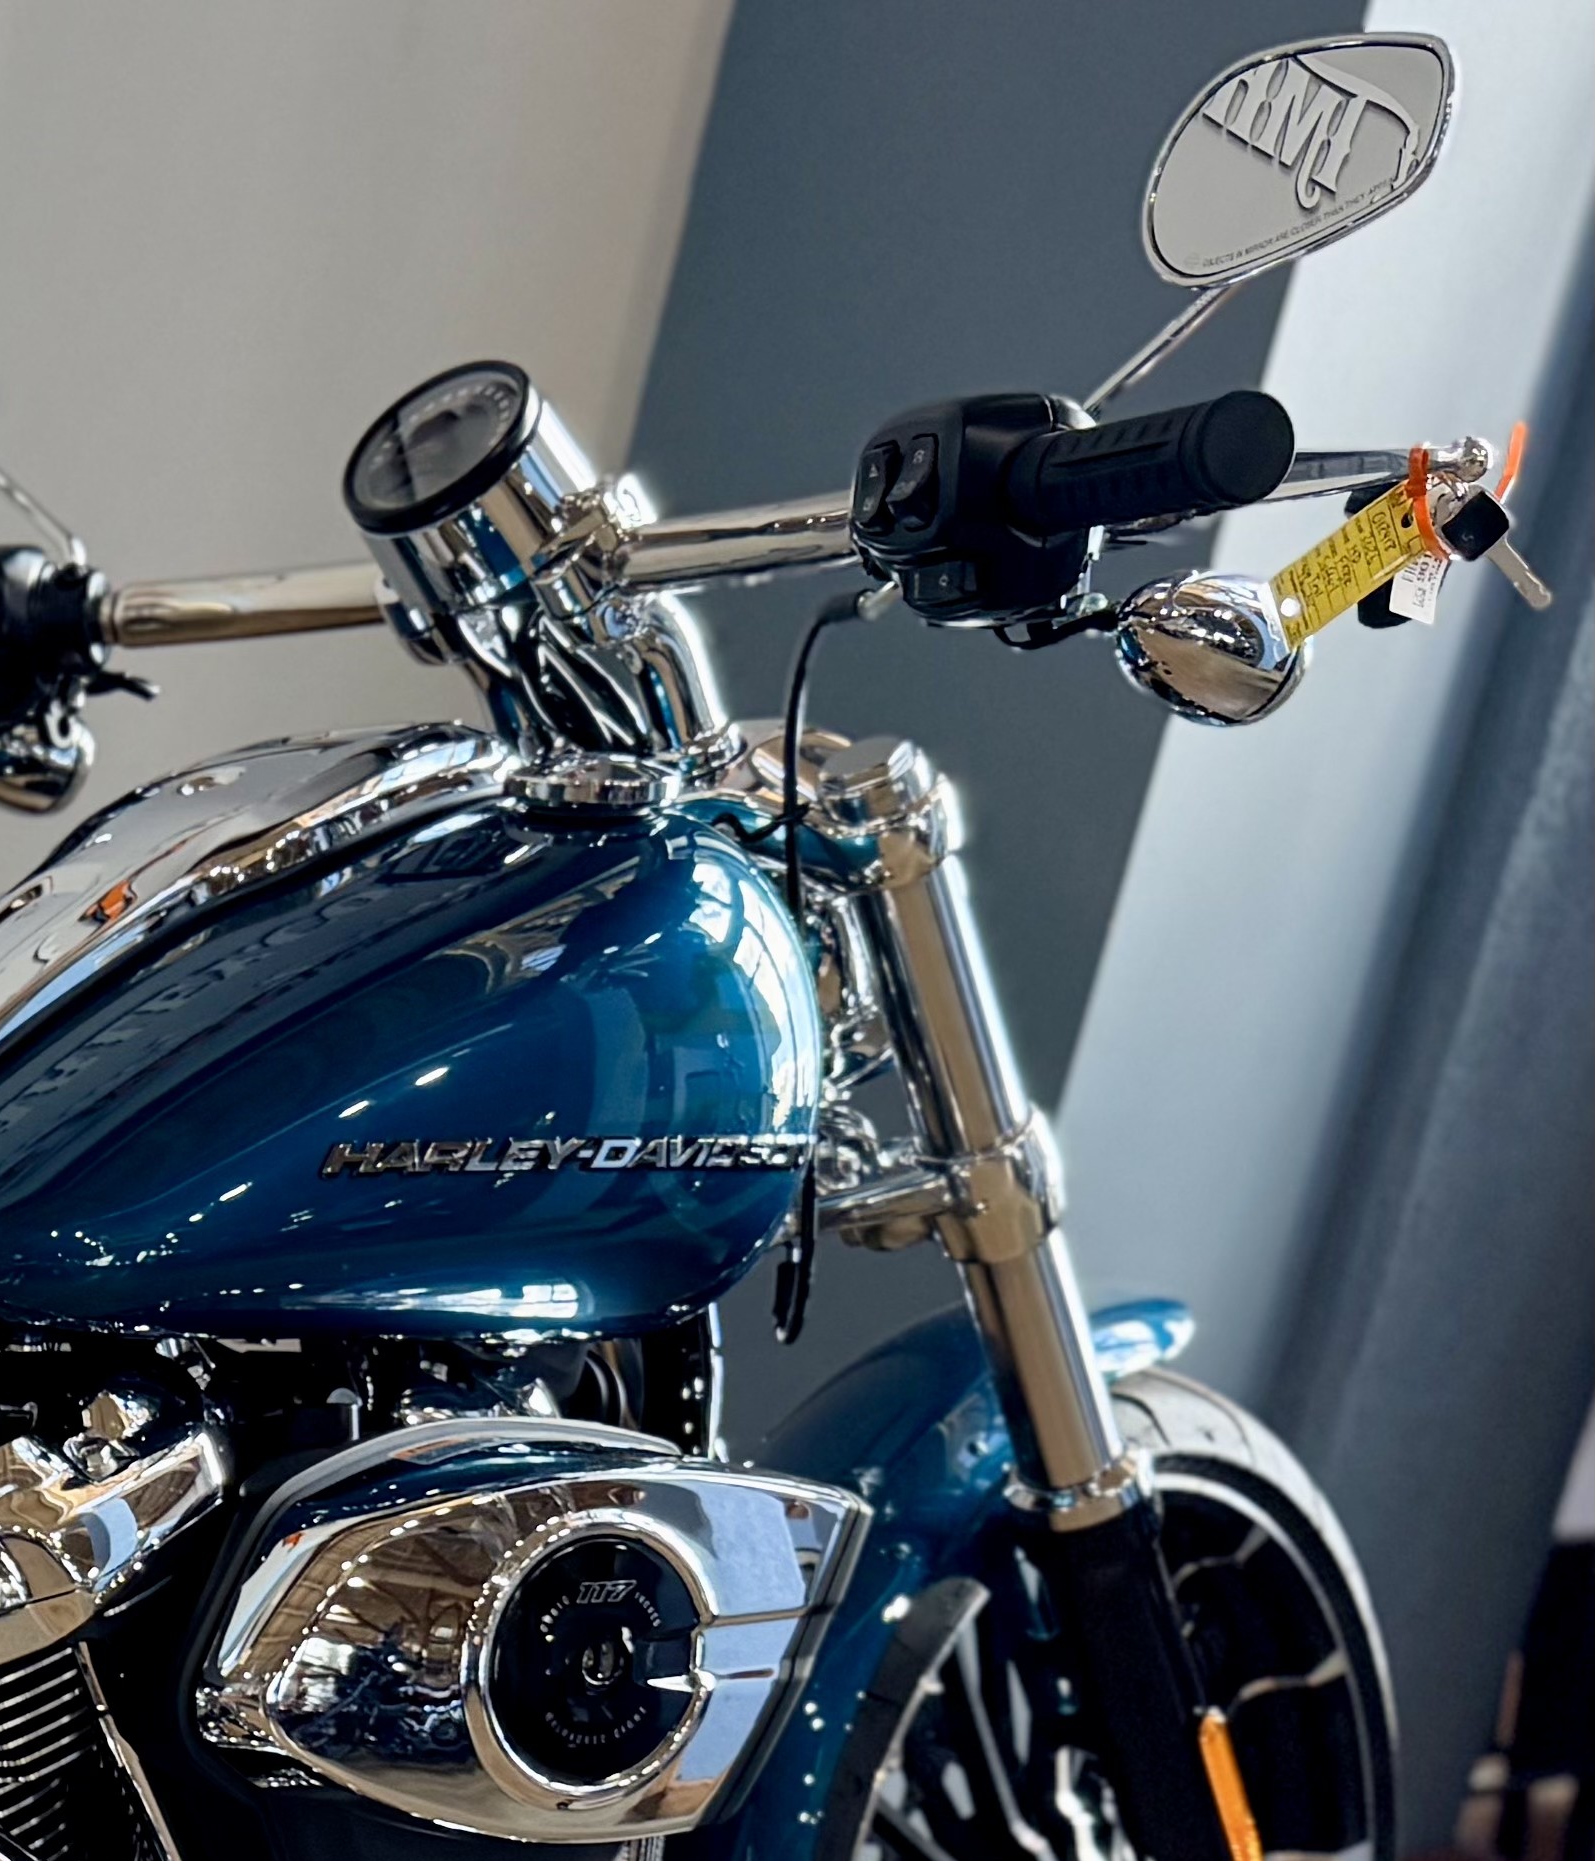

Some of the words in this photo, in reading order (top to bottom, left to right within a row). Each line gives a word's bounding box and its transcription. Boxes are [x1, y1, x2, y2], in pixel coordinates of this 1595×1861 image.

[1245, 237, 1273, 255] MIRROR
[1275, 230, 1289, 241] ARE
[1323, 206, 1344, 219] THAN
[576, 1580, 636, 1604] 117
[634, 1592, 662, 1627] INCHES
